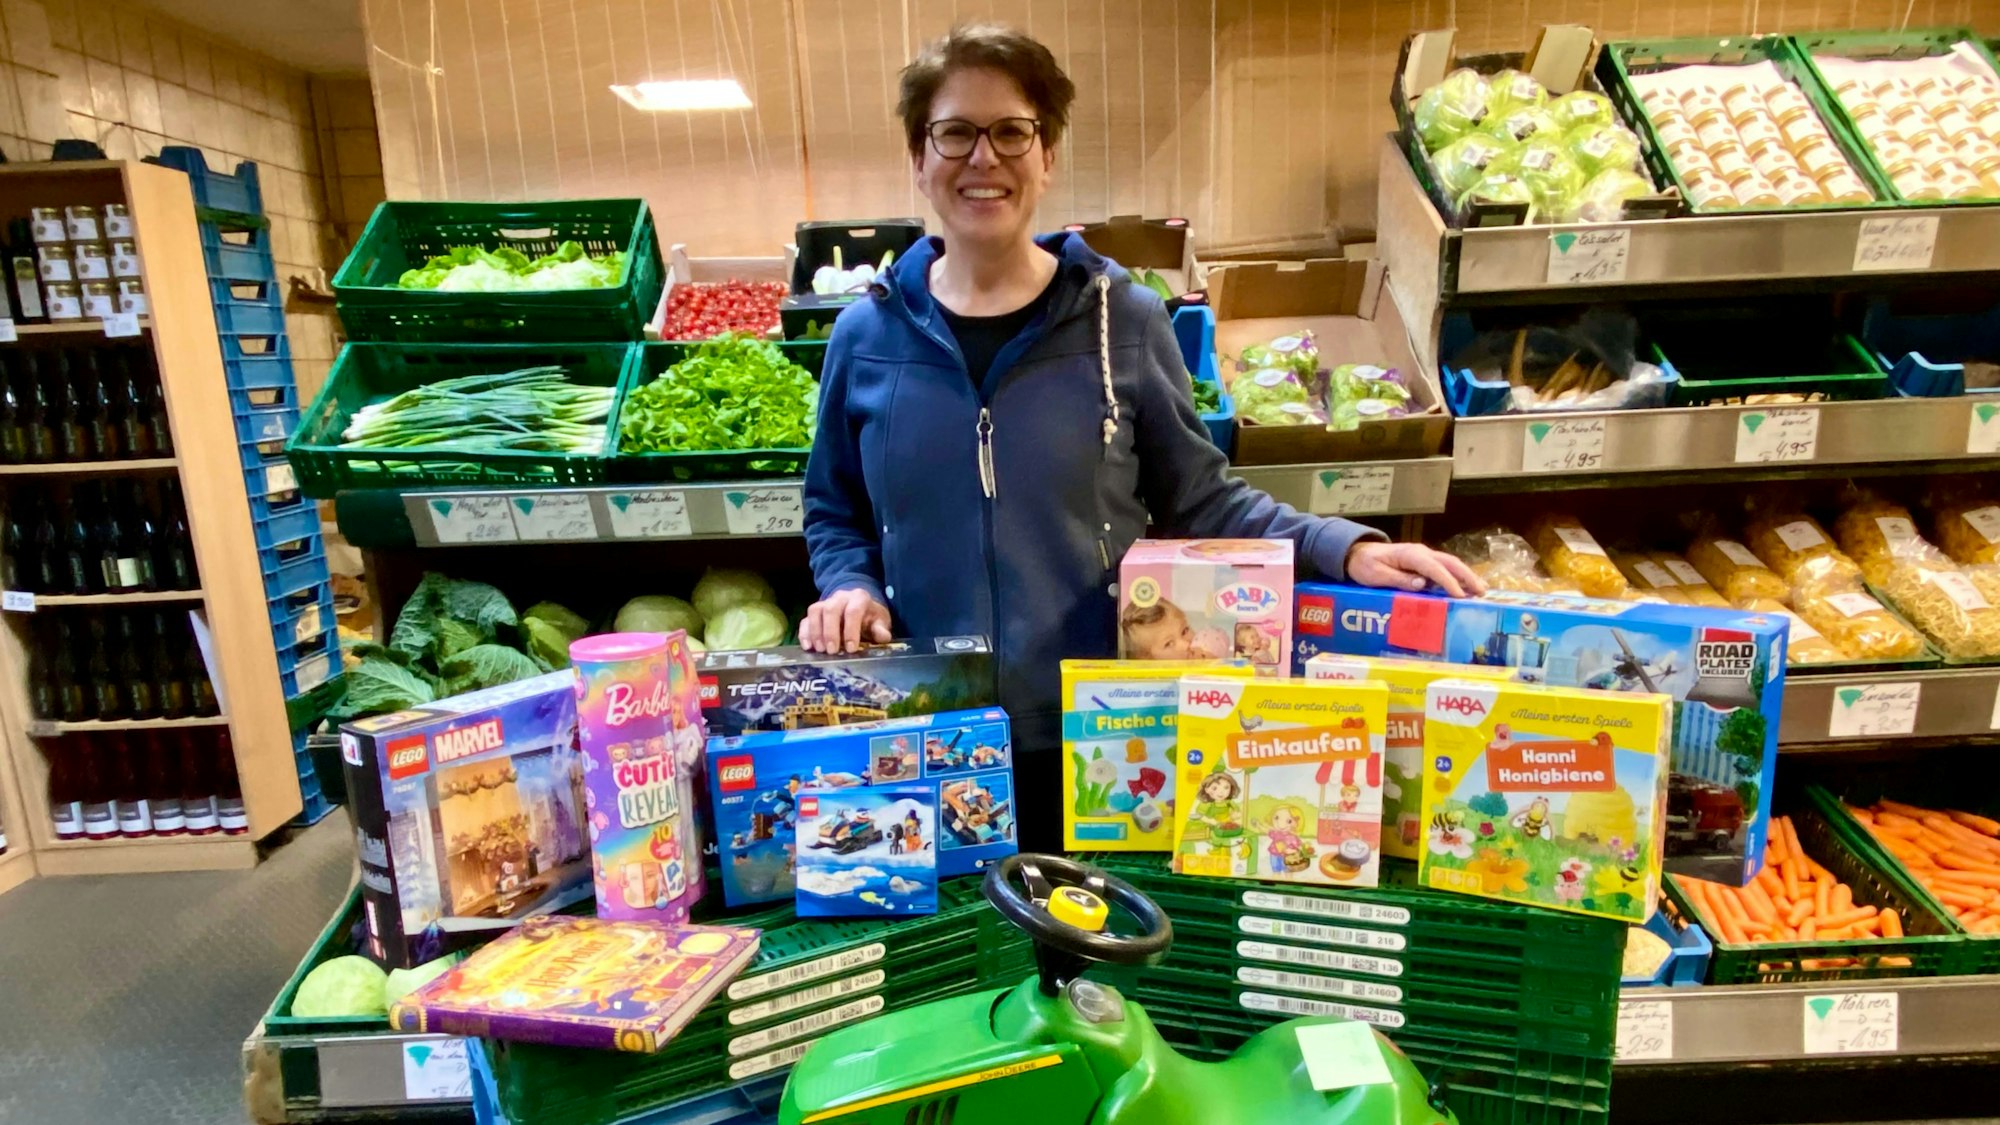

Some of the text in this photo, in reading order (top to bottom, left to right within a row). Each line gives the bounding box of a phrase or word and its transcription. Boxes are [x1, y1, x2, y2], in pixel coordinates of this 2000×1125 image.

[1776, 441, 1813, 460] 4,95
[1220, 587, 1276, 608] BABY
[1301, 608, 1392, 635] LEGO CITY
[1298, 640, 1318, 655] 6+
[1700, 645, 1754, 658] ROAD
[1700, 659, 1750, 669] PLATES
[727, 679, 827, 697] TECHNIC
[1188, 690, 1234, 709] HABA
[1256, 699, 1292, 711] Meine
[1294, 701, 1327, 712] ersten
[1437, 696, 1486, 716] HABA
[1510, 708, 1550, 721] Meine
[1552, 713, 1590, 725] ersten
[1096, 713, 1156, 731] Fische
[1387, 720, 1420, 740] ähl
[392, 721, 503, 767] LEGO MARVEL
[1237, 732, 1362, 759] Einkaufen
[1188, 752, 1202, 762] 2+
[1437, 759, 1450, 769] 2+
[1522, 749, 1576, 764] Hanni
[723, 766, 752, 780] LEGO
[1498, 768, 1605, 785] Honigbiene
[801, 802, 818, 811] LEGO
[1375, 908, 1406, 920] 24603
[1377, 936, 1395, 946] 216
[1382, 963, 1400, 973] 136
[854, 973, 881, 987] 24603
[1367, 986, 1398, 998] 24603
[1837, 993, 1892, 1013] Möhren
[1382, 1014, 1401, 1024] 216
[978, 1061, 1037, 1082] JOHN DEERE
